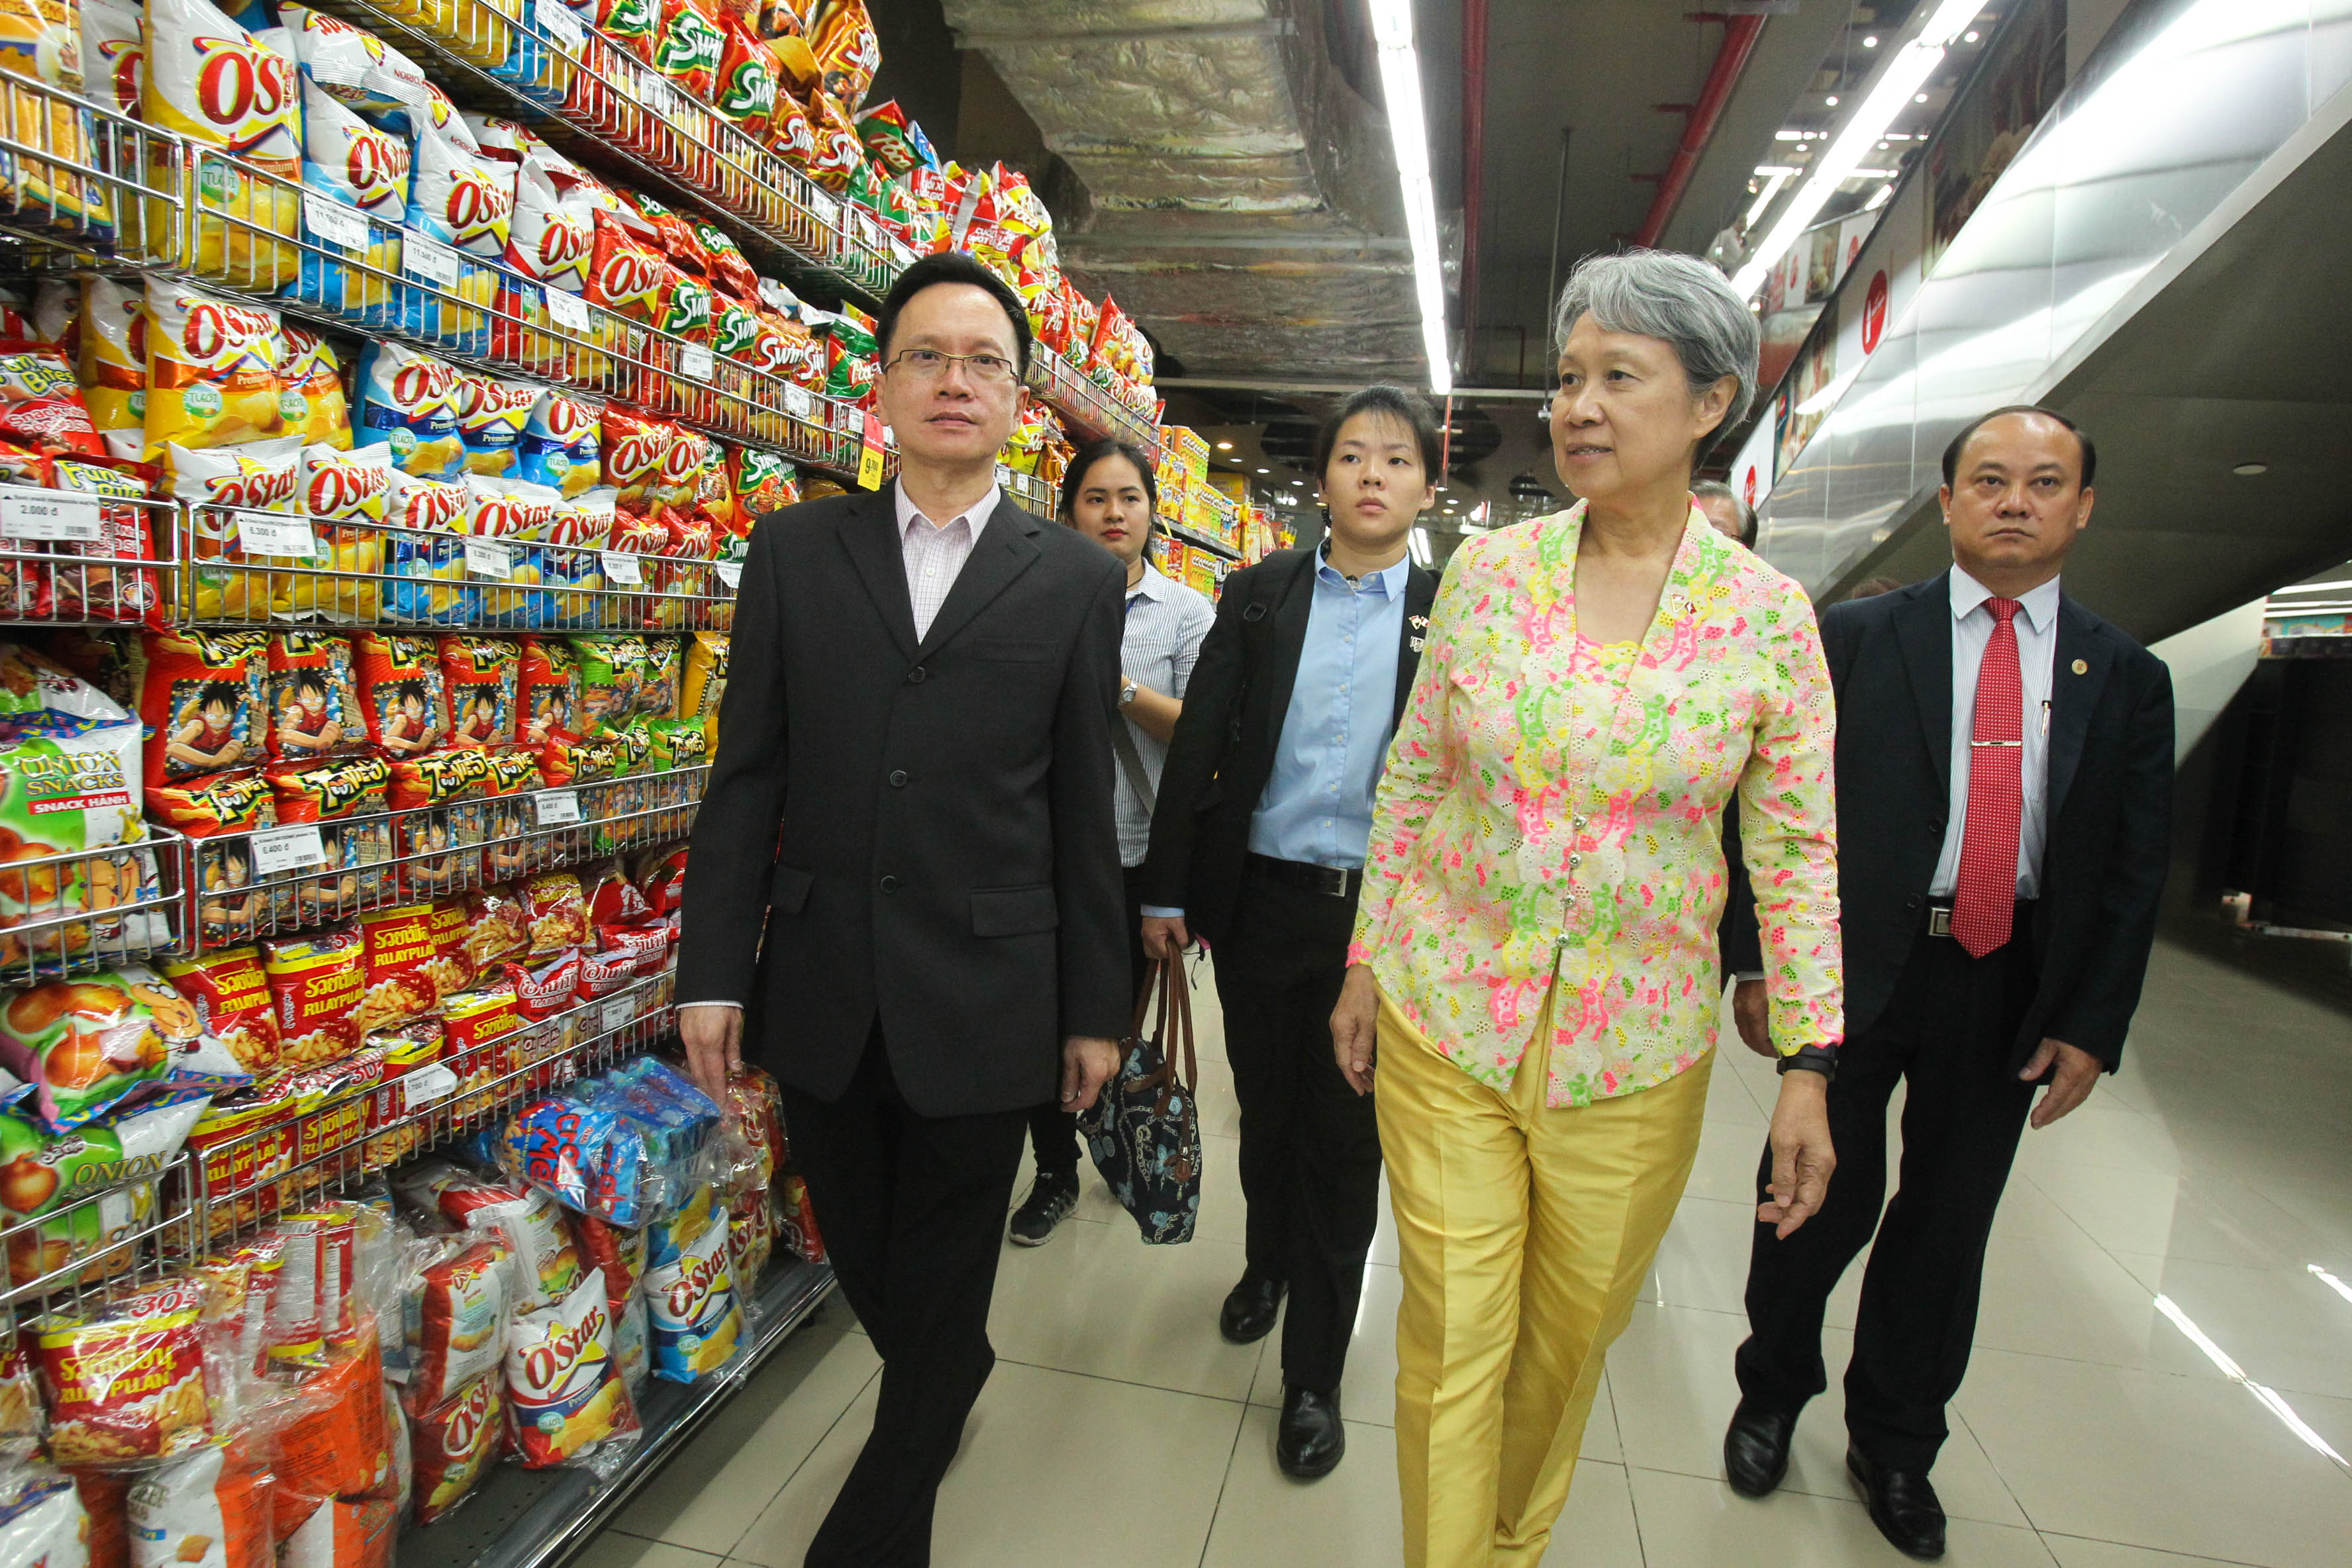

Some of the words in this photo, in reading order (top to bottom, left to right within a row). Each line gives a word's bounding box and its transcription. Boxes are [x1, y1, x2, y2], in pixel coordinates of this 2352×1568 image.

[871, 132, 912, 170] Poca
[756, 337, 803, 372] Swin
[21, 366, 76, 393] Bites
[483, 434, 514, 443] Premium
[56, 460, 118, 488] Fun
[309, 466, 385, 515] O'Star
[21, 505, 48, 516] 2.000
[20, 750, 122, 778] ONION
[26, 772, 126, 796] SNACKS
[34, 799, 87, 814] SNACK
[74, 1151, 168, 1187] ONION
[528, 1126, 560, 1181] Me
[667, 1242, 726, 1317] O'Star
[526, 1306, 598, 1390] O'Star
